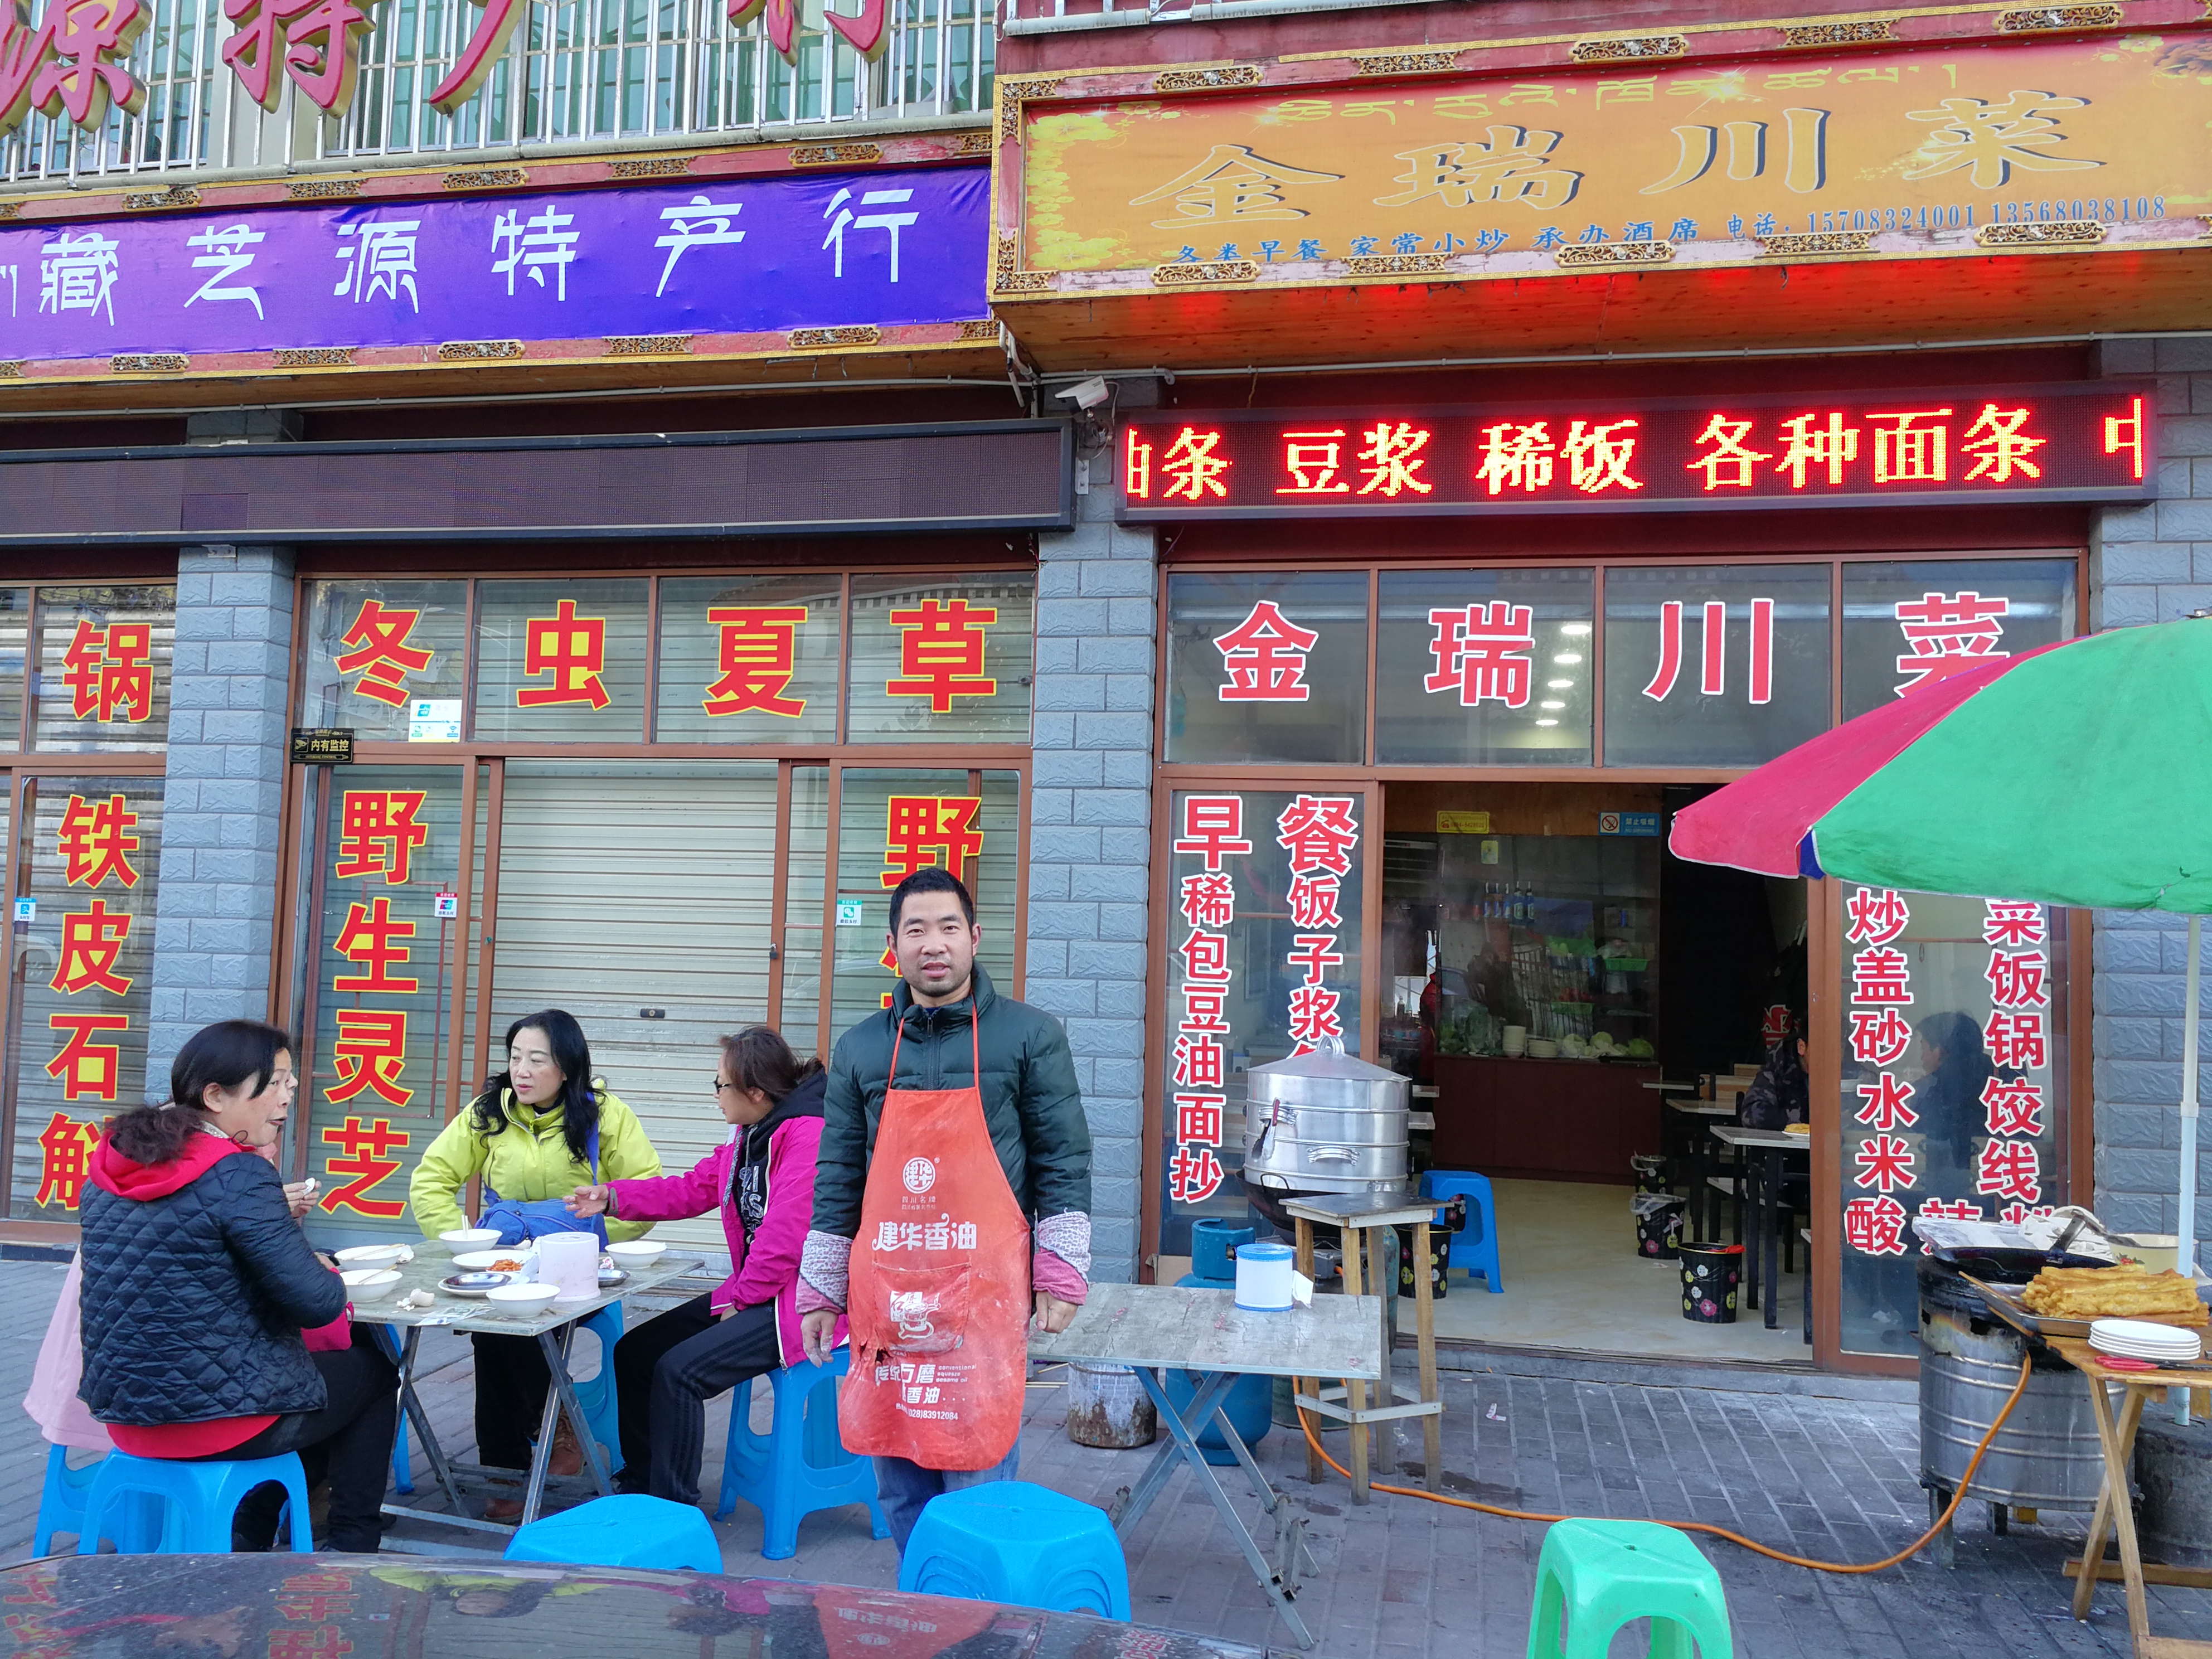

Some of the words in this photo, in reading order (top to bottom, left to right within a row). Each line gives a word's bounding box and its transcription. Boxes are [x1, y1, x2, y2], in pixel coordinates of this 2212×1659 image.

[1128, 90, 2107, 230] 金瑞川菜
[1171, 237, 1328, 262] 各类早餐
[1350, 229, 1509, 256] 家常小炒
[1530, 217, 1699, 250] 承办酒席
[1807, 203, 1974, 233] 15708324001
[1991, 196, 2165, 224] 13568038108
[1275, 422, 1433, 497] 豆浆
[1475, 419, 1644, 495] 稀饭
[1686, 403, 2046, 491] 各种面条
[62, 619, 153, 723] 锅
[333, 598, 998, 719] 冬虫夏草
[1212, 592, 2010, 709] 金瑞川菜
[311, 739, 349, 752] 内有监控
[318, 790, 429, 1219] 野生灵芝
[872, 1212, 977, 1251] 建华香油
